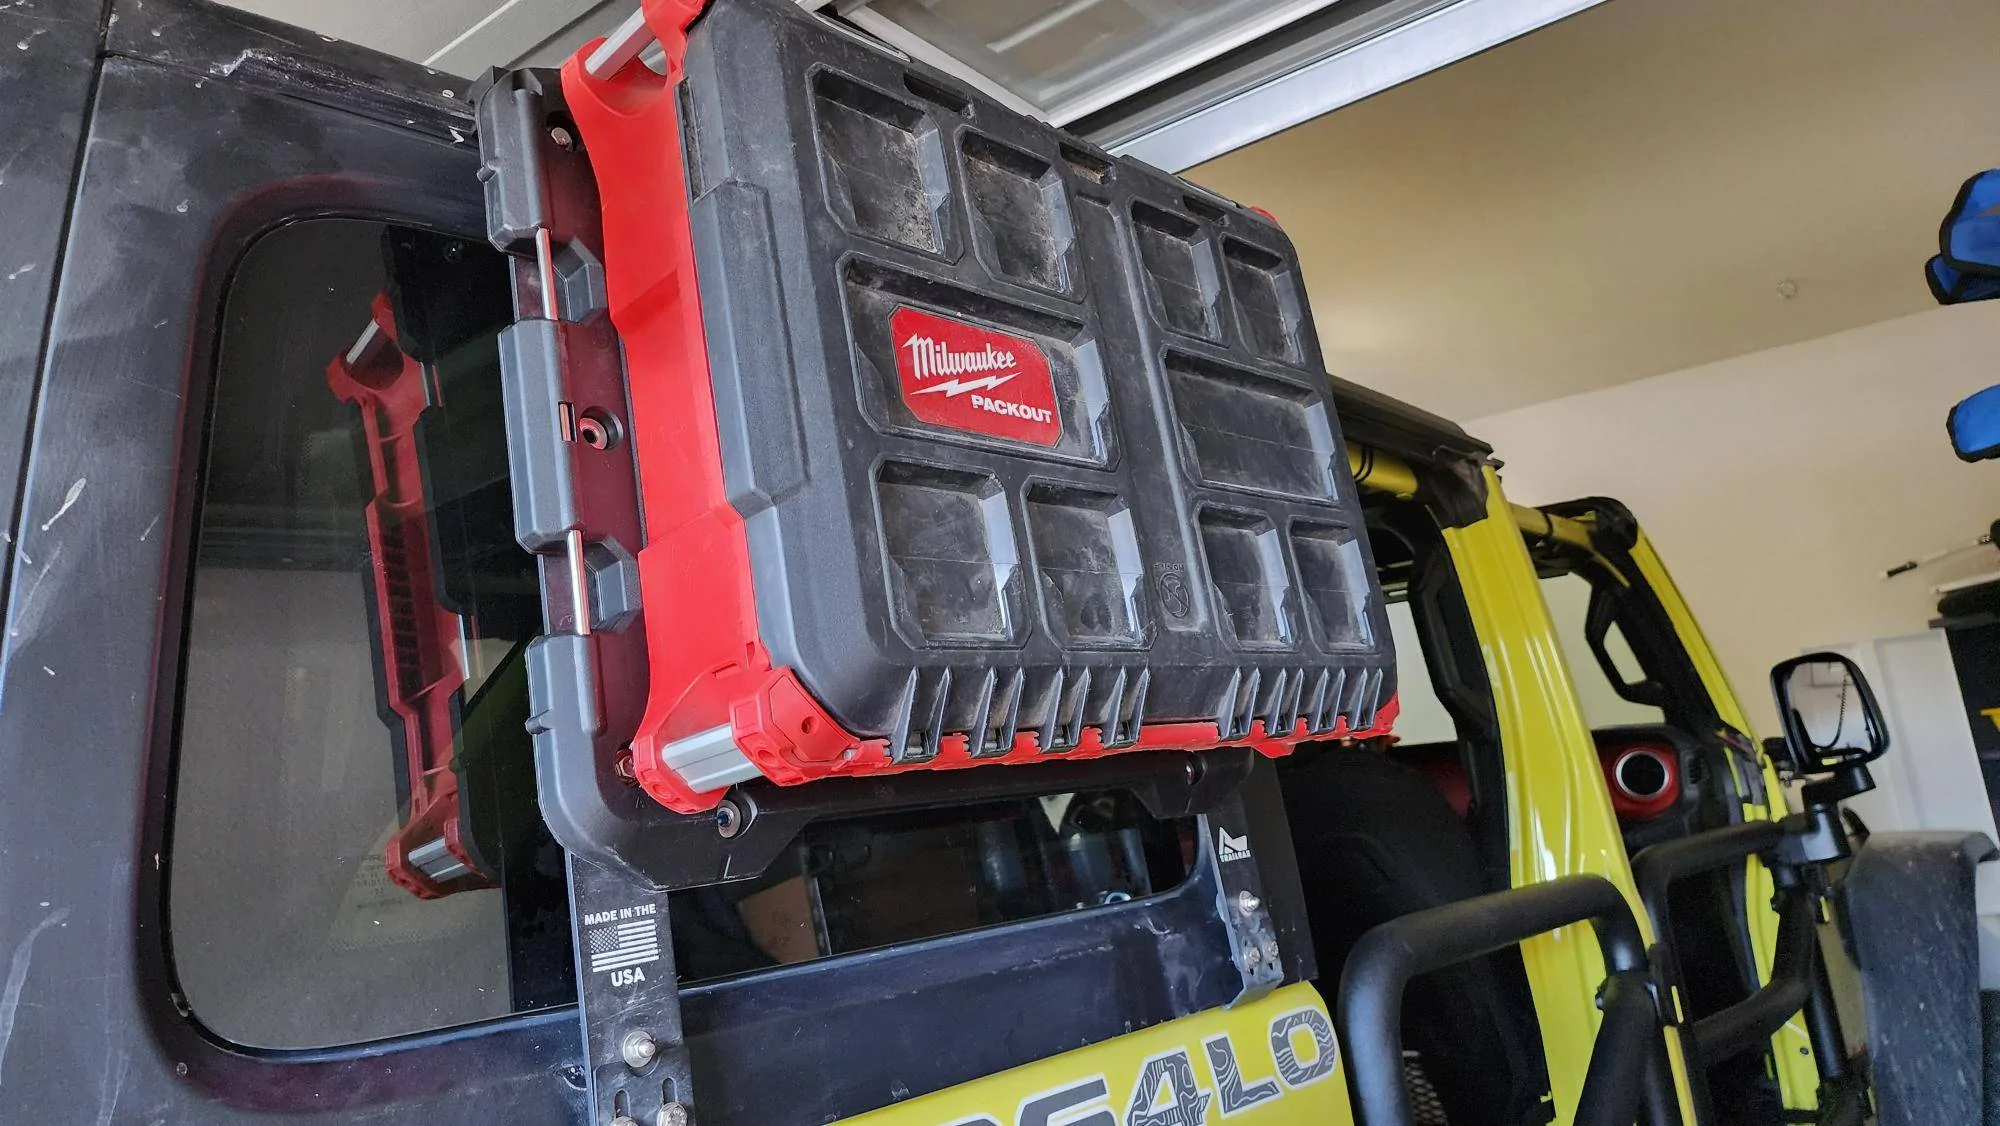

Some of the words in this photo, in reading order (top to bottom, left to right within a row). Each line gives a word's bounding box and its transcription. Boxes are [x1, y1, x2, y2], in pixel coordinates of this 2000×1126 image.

[900, 332, 1017, 381] Milwaukee
[971, 394, 1052, 424] PACKOUT
[584, 910, 618, 926] MADE
[620, 907, 632, 919] IN
[634, 903, 657, 917] THE
[610, 967, 646, 987] USA
